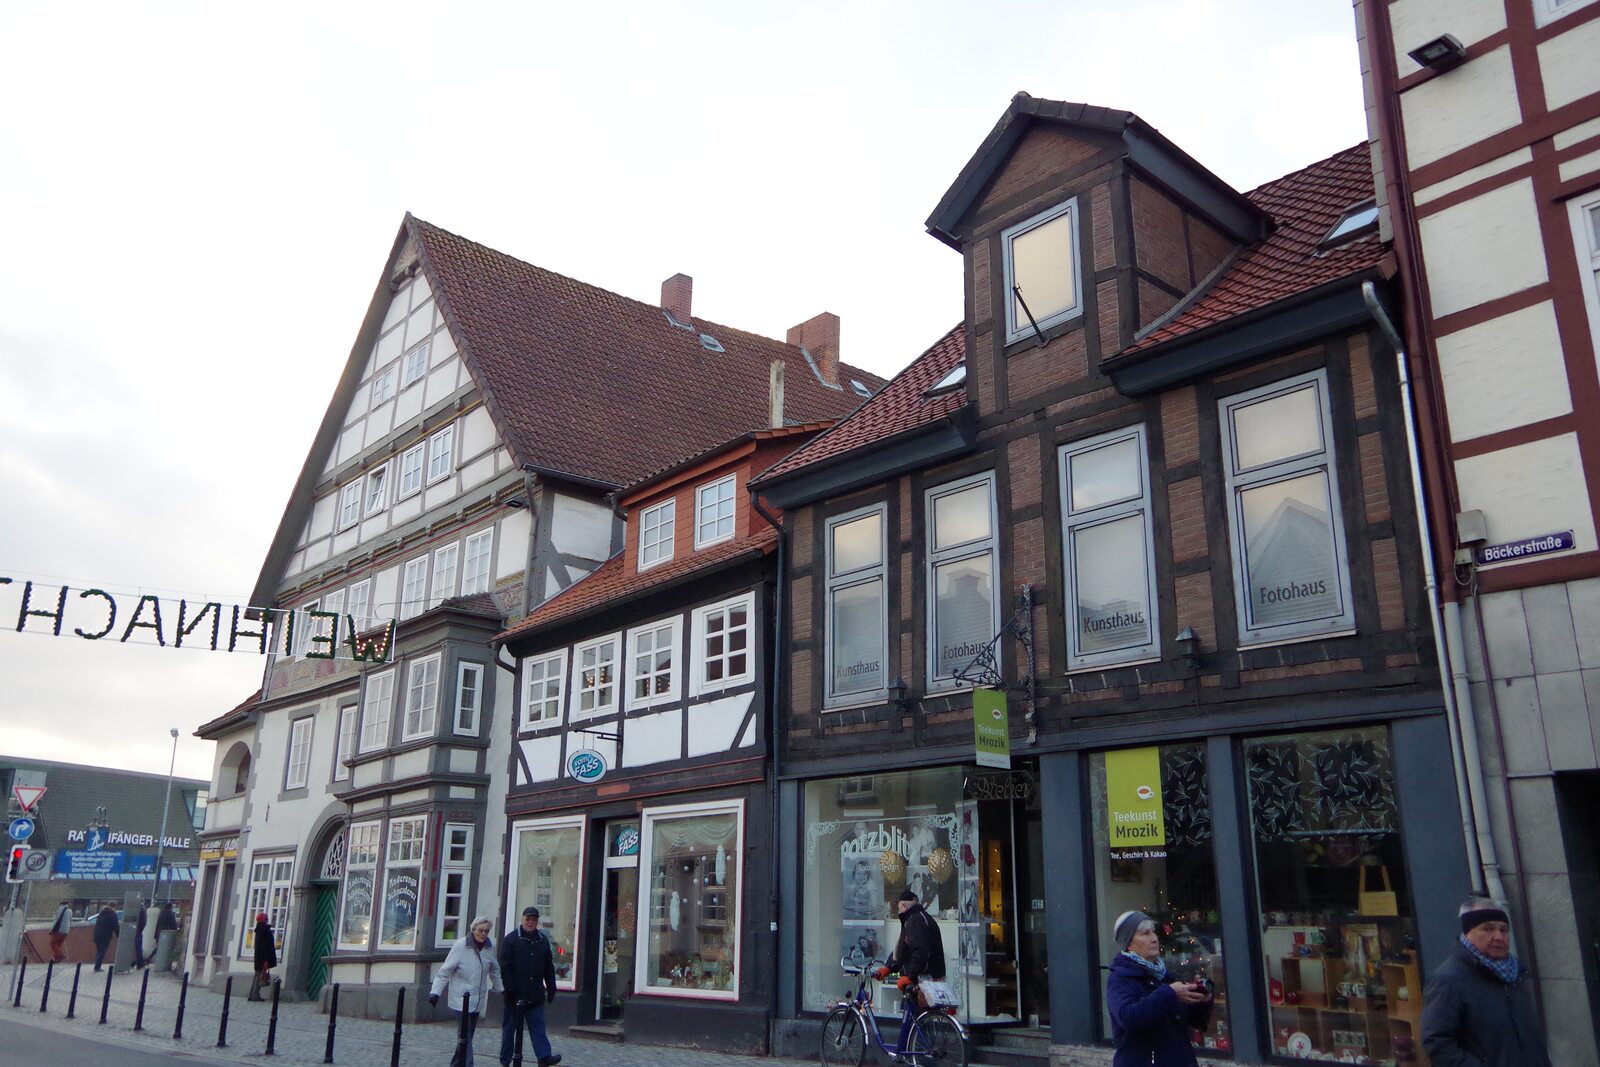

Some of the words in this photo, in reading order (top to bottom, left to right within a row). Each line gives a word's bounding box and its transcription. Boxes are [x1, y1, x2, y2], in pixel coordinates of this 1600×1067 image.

[1484, 536, 1562, 561] Bäckerstraße
[1260, 580, 1327, 604] Fotohaus
[1084, 611, 1145, 633] Kunsthaus
[943, 641, 987, 660] Fotohaus
[836, 660, 880, 679] Kunsthaus
[978, 724, 1005, 736] Teekunst
[979, 735, 1006, 748] Mrozik
[575, 758, 599, 778] FASS
[1113, 810, 1158, 822] Teekunst
[67, 829, 153, 846] RAFÄNGER
[1116, 823, 1159, 838] Mrozik
[618, 831, 639, 856] FASS
[30, 856, 43, 867] 30
[1110, 852, 1122, 860] Tee,
[1122, 851, 1144, 859] Geschirr
[1150, 850, 1167, 858] Kakao
[395, 898, 408, 909] City
